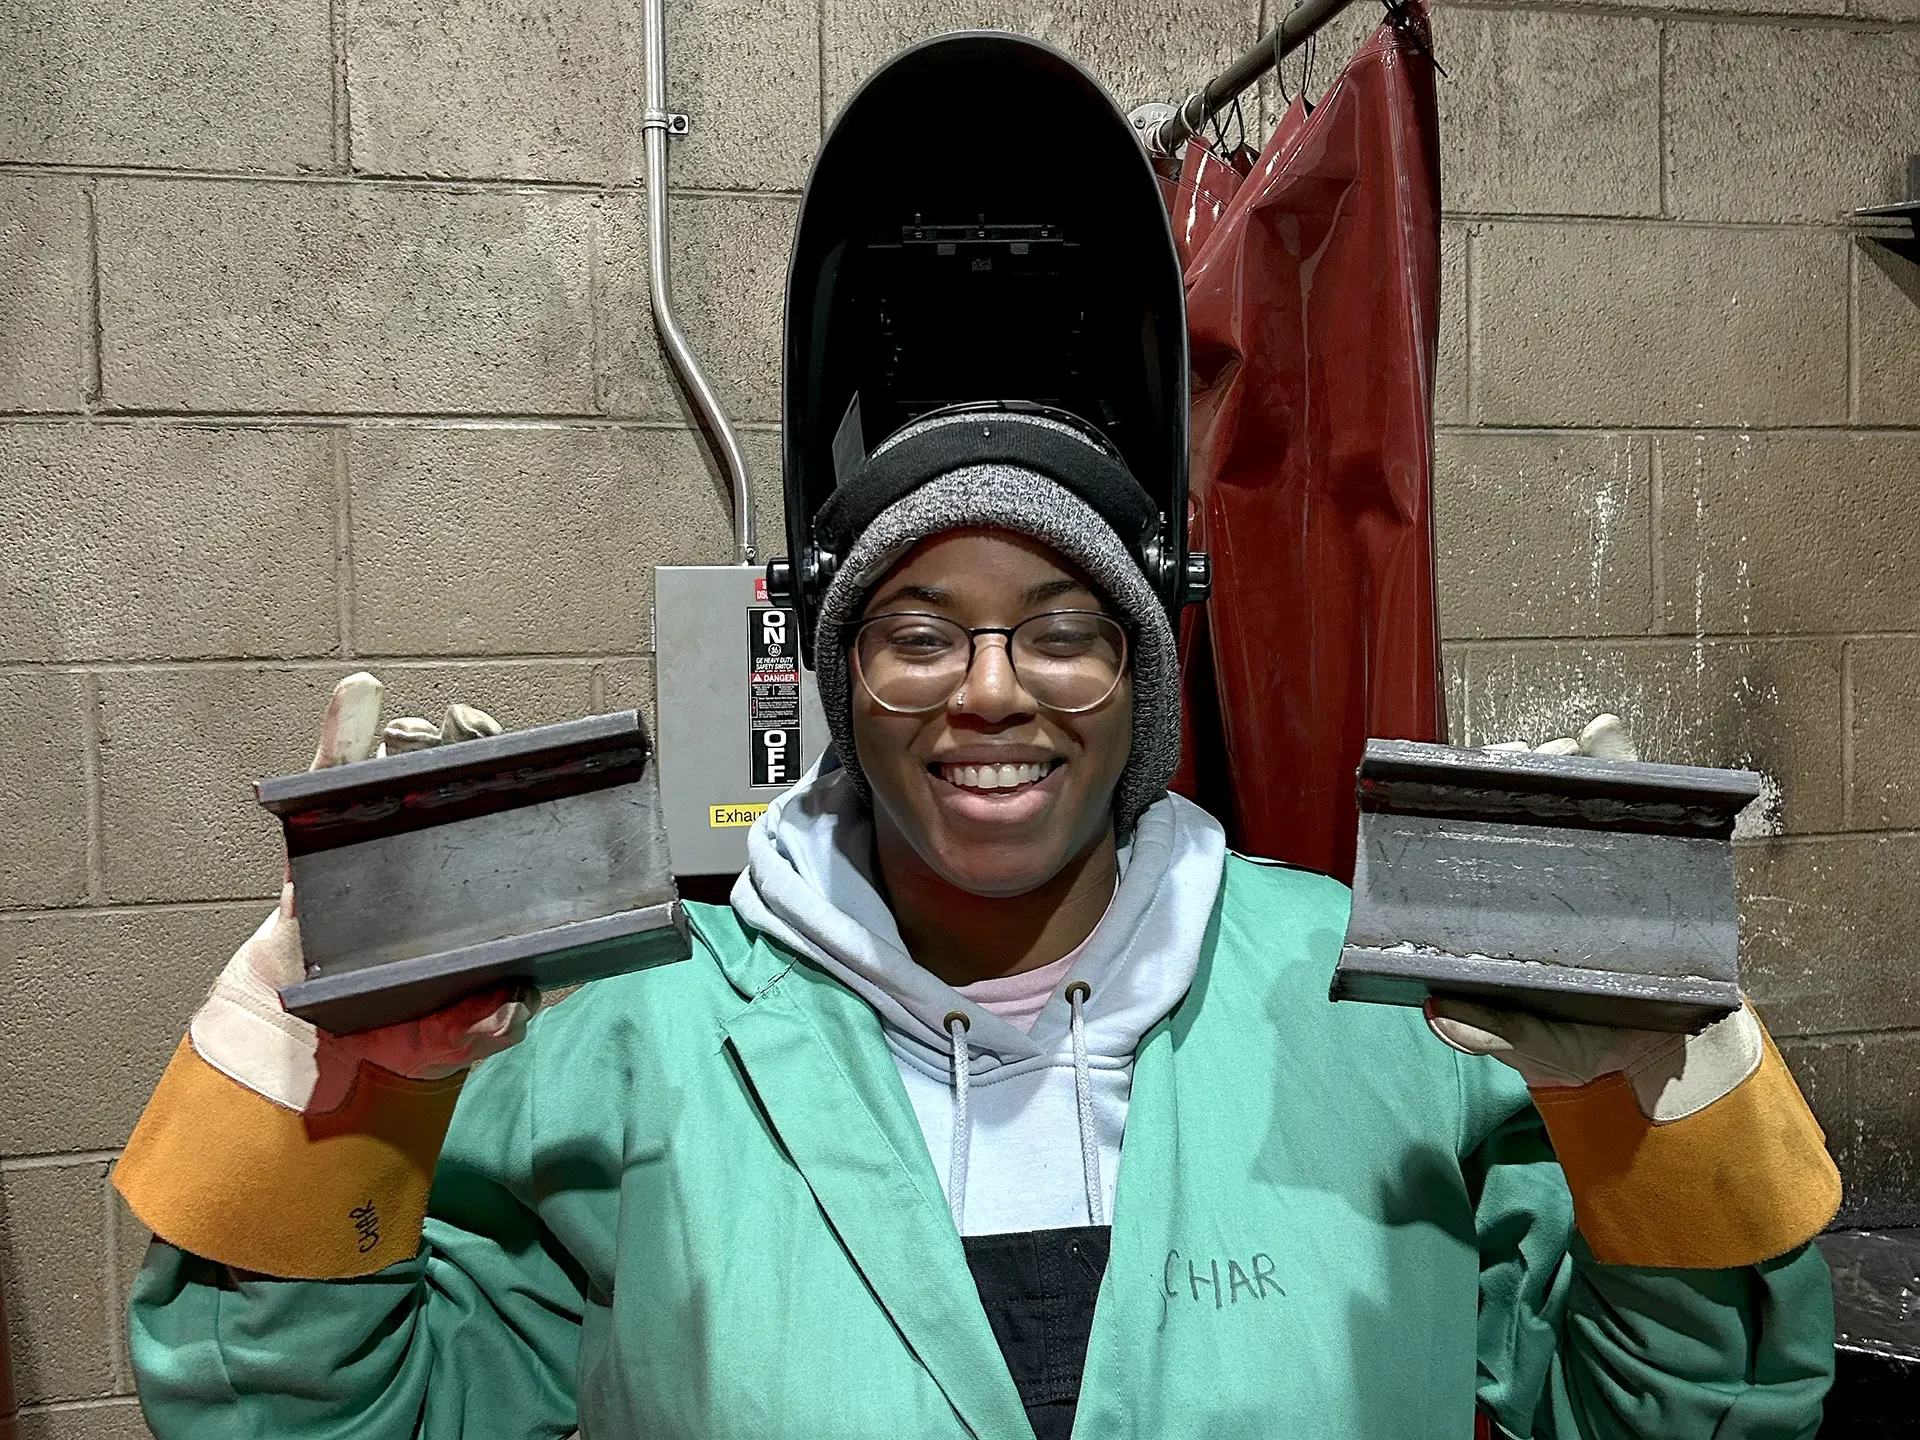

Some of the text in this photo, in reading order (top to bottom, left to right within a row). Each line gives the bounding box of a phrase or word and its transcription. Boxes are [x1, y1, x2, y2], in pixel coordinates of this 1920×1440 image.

[762, 610, 785, 644] ON
[763, 674, 795, 682] DANGER
[764, 729, 787, 783] OFF
[715, 808, 767, 823] Exhau
[348, 1198, 381, 1253] CHAR
[1163, 1249, 1287, 1310] CHAR
